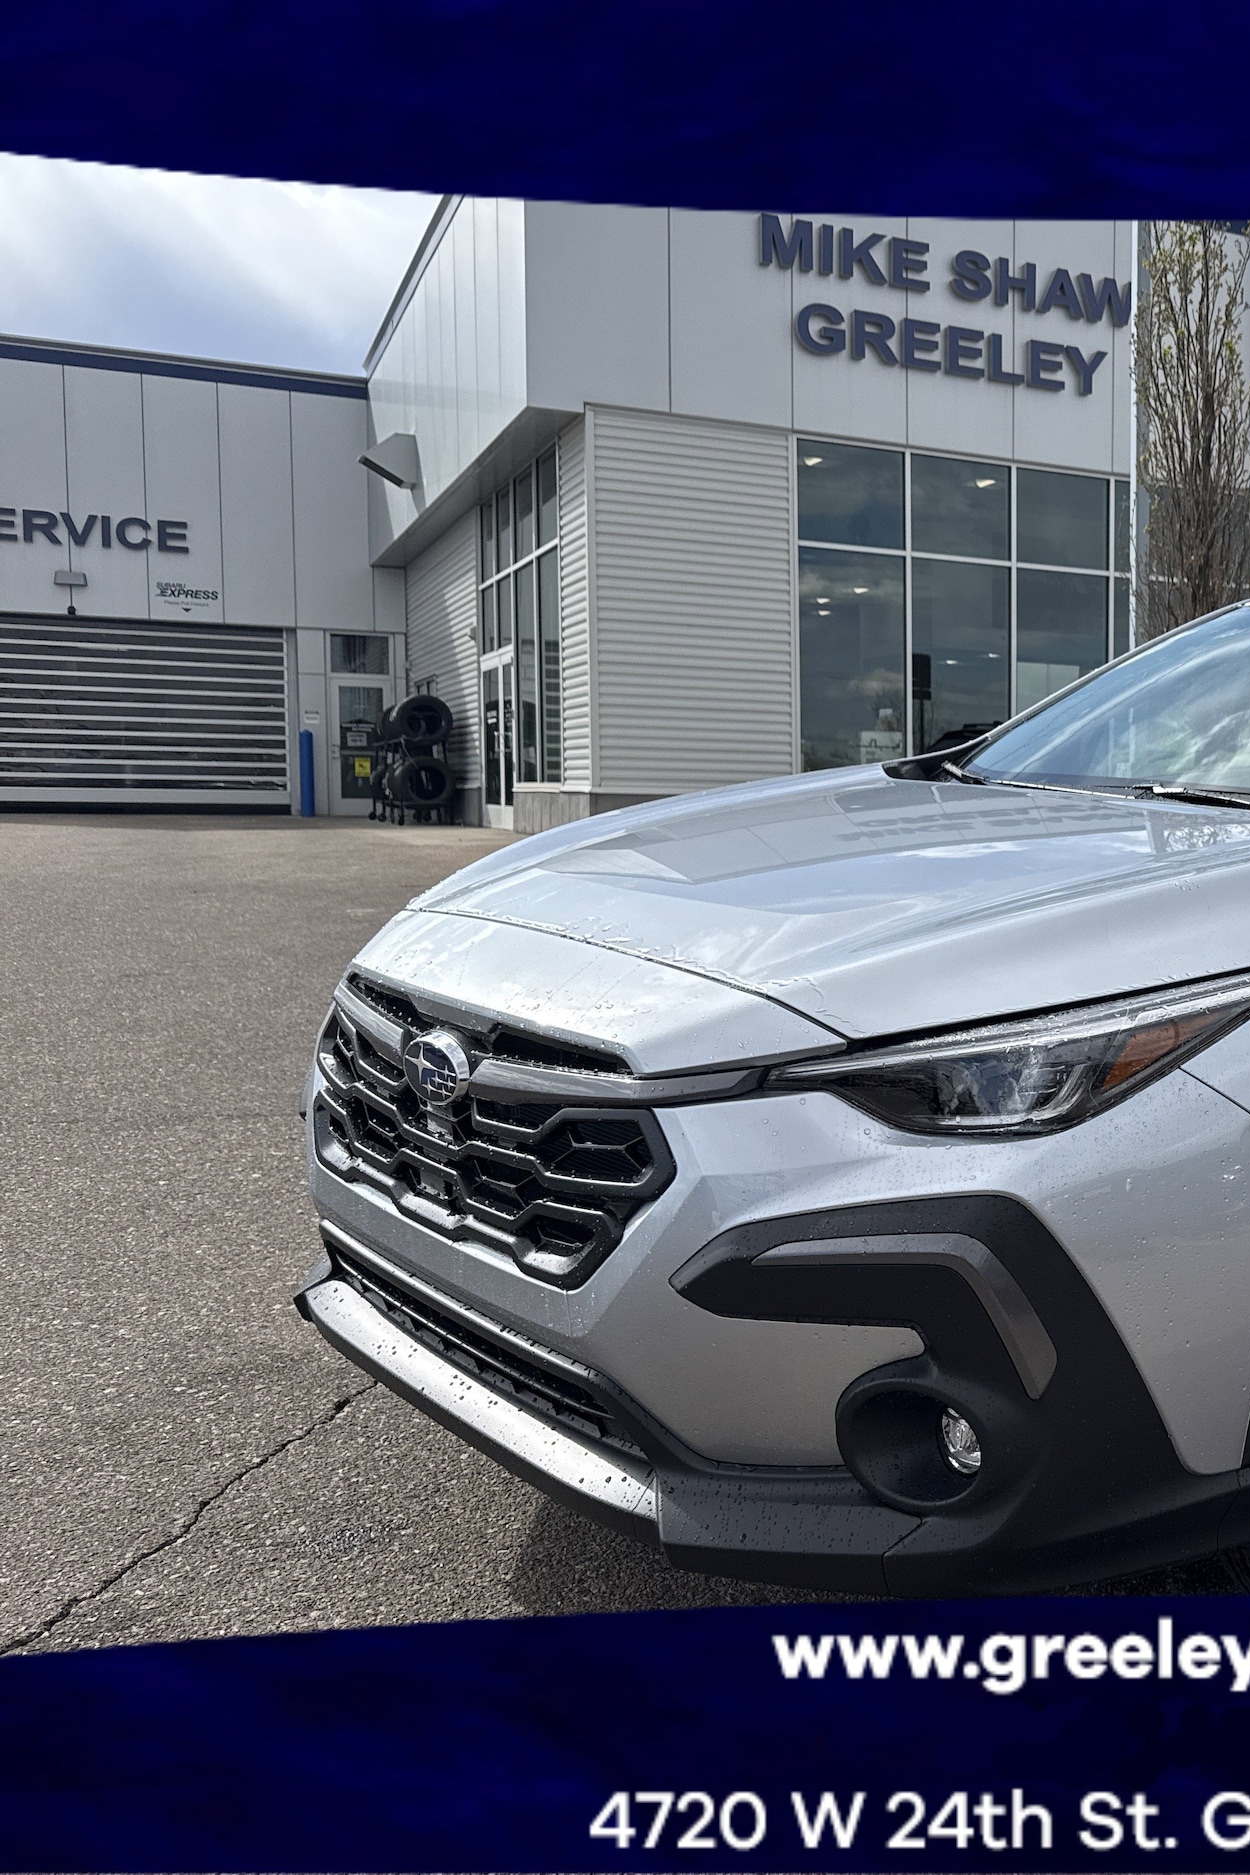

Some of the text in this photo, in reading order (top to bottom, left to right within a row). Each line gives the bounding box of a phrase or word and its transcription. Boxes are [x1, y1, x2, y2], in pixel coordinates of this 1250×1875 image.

[759, 212, 1132, 328] MIKE SHAW
[795, 302, 1109, 396] GREELEY
[158, 588, 219, 600] EXPRESS
